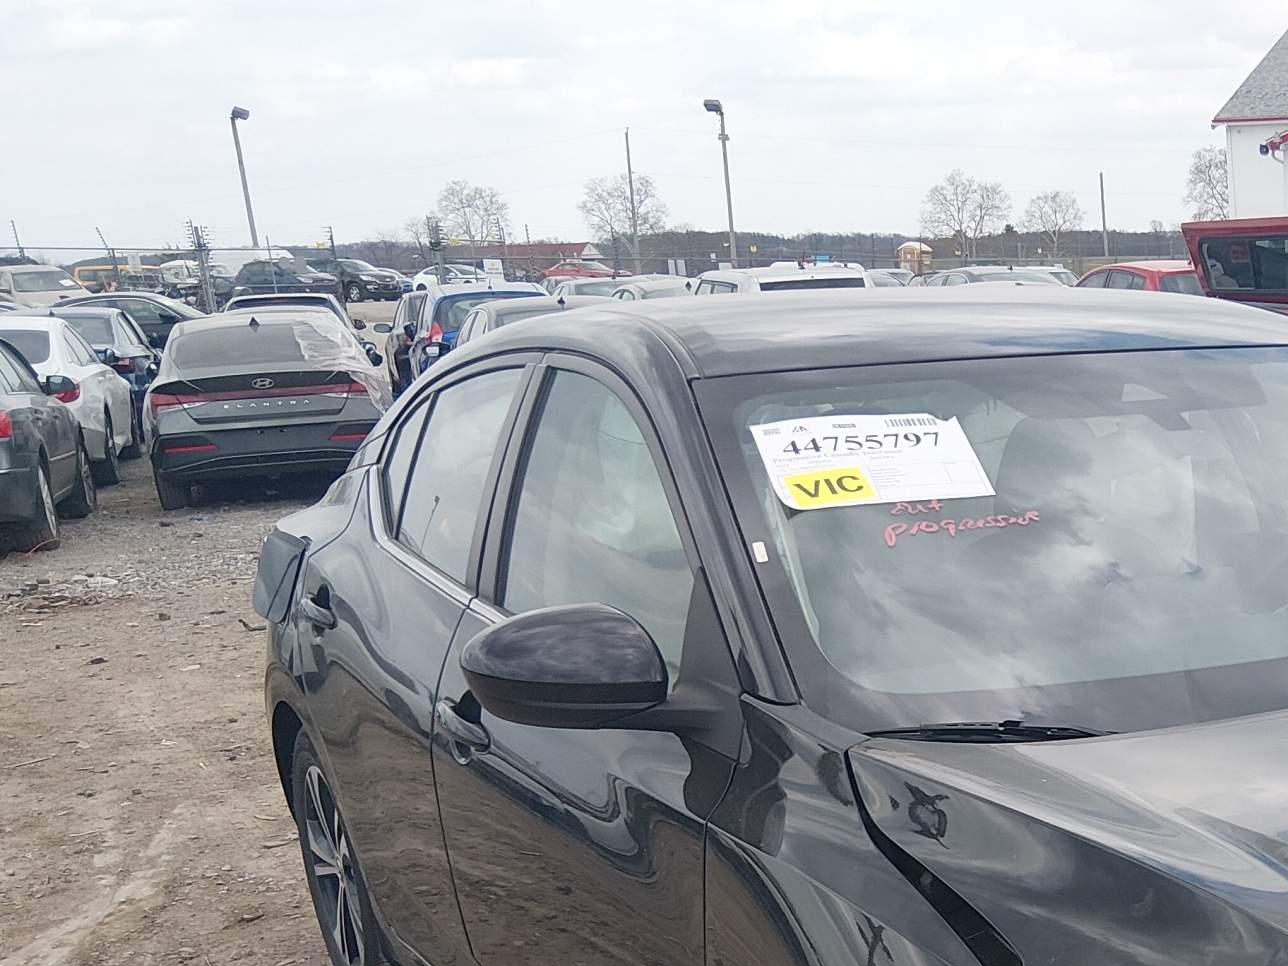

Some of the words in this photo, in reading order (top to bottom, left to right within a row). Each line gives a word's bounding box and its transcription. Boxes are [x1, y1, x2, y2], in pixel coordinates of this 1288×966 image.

[223, 399, 310, 409] ELANTRA
[783, 431, 940, 456] 44755797
[793, 475, 864, 499] VIC
